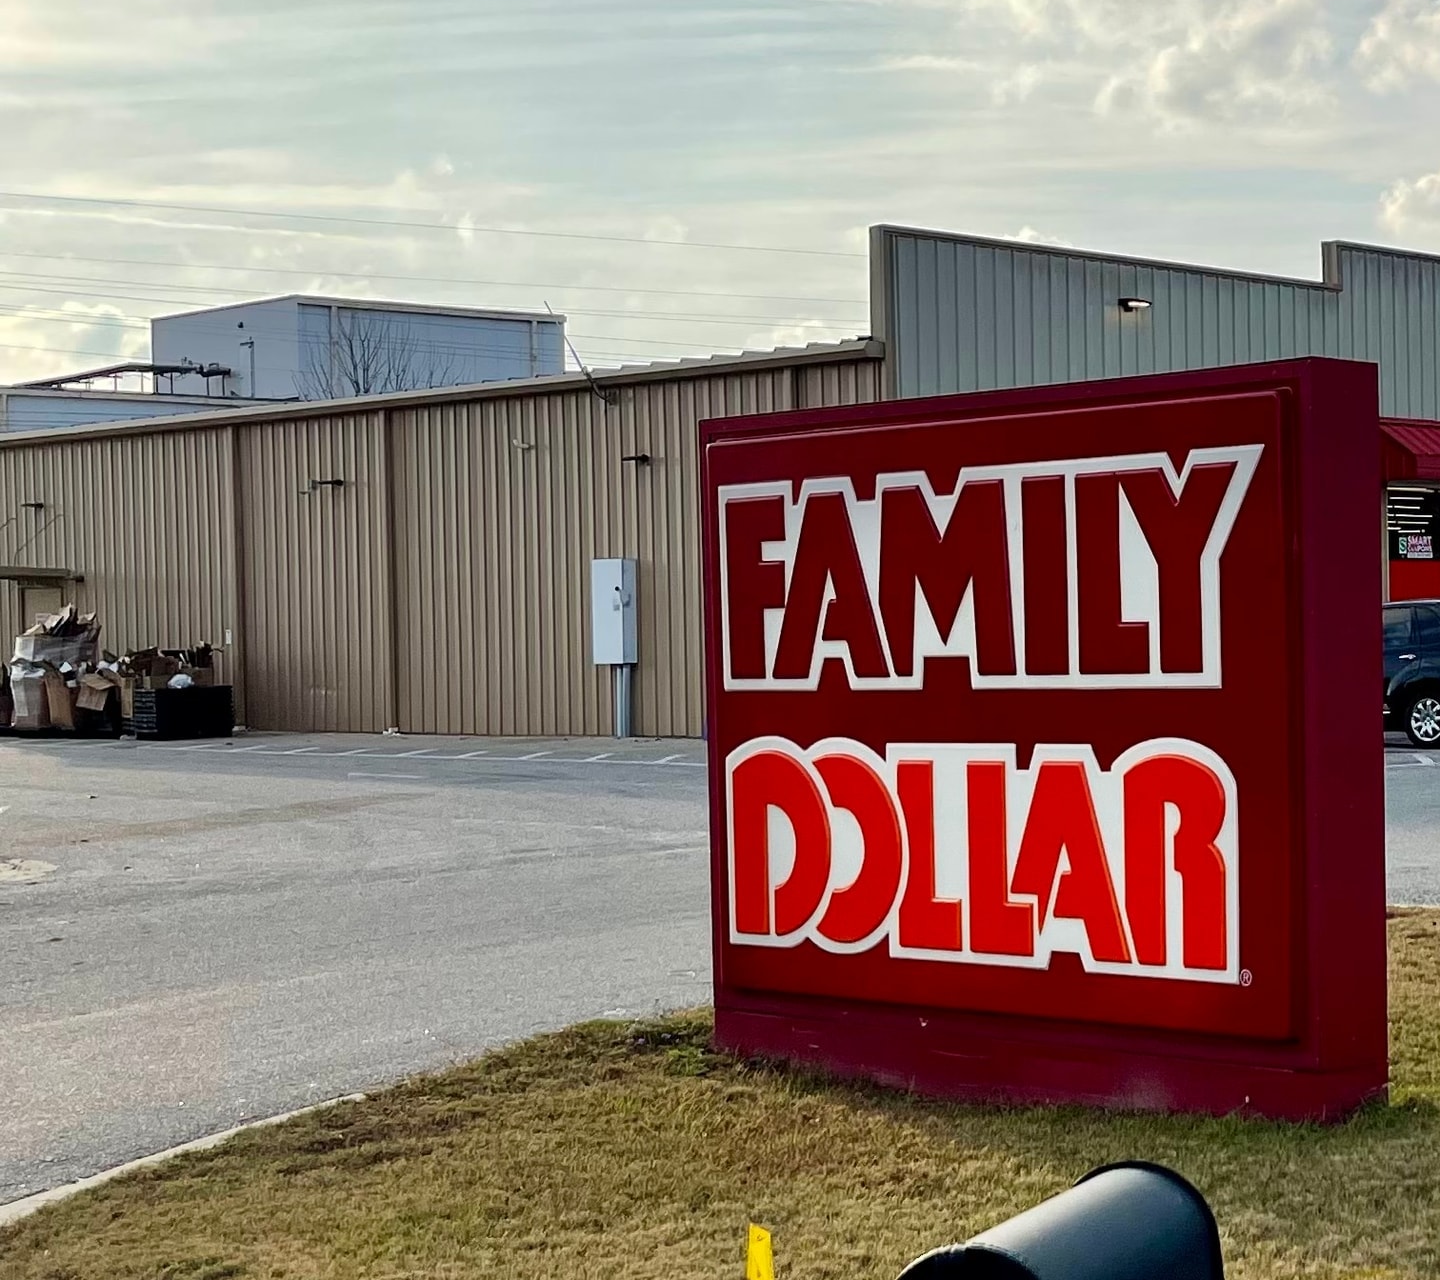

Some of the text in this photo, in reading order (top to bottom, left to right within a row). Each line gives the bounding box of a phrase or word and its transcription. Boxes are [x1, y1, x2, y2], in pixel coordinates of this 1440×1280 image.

[718, 444, 1264, 690] FAMILY
[1407, 535, 1433, 544] SMART
[726, 736, 1240, 984] DOLLAR
